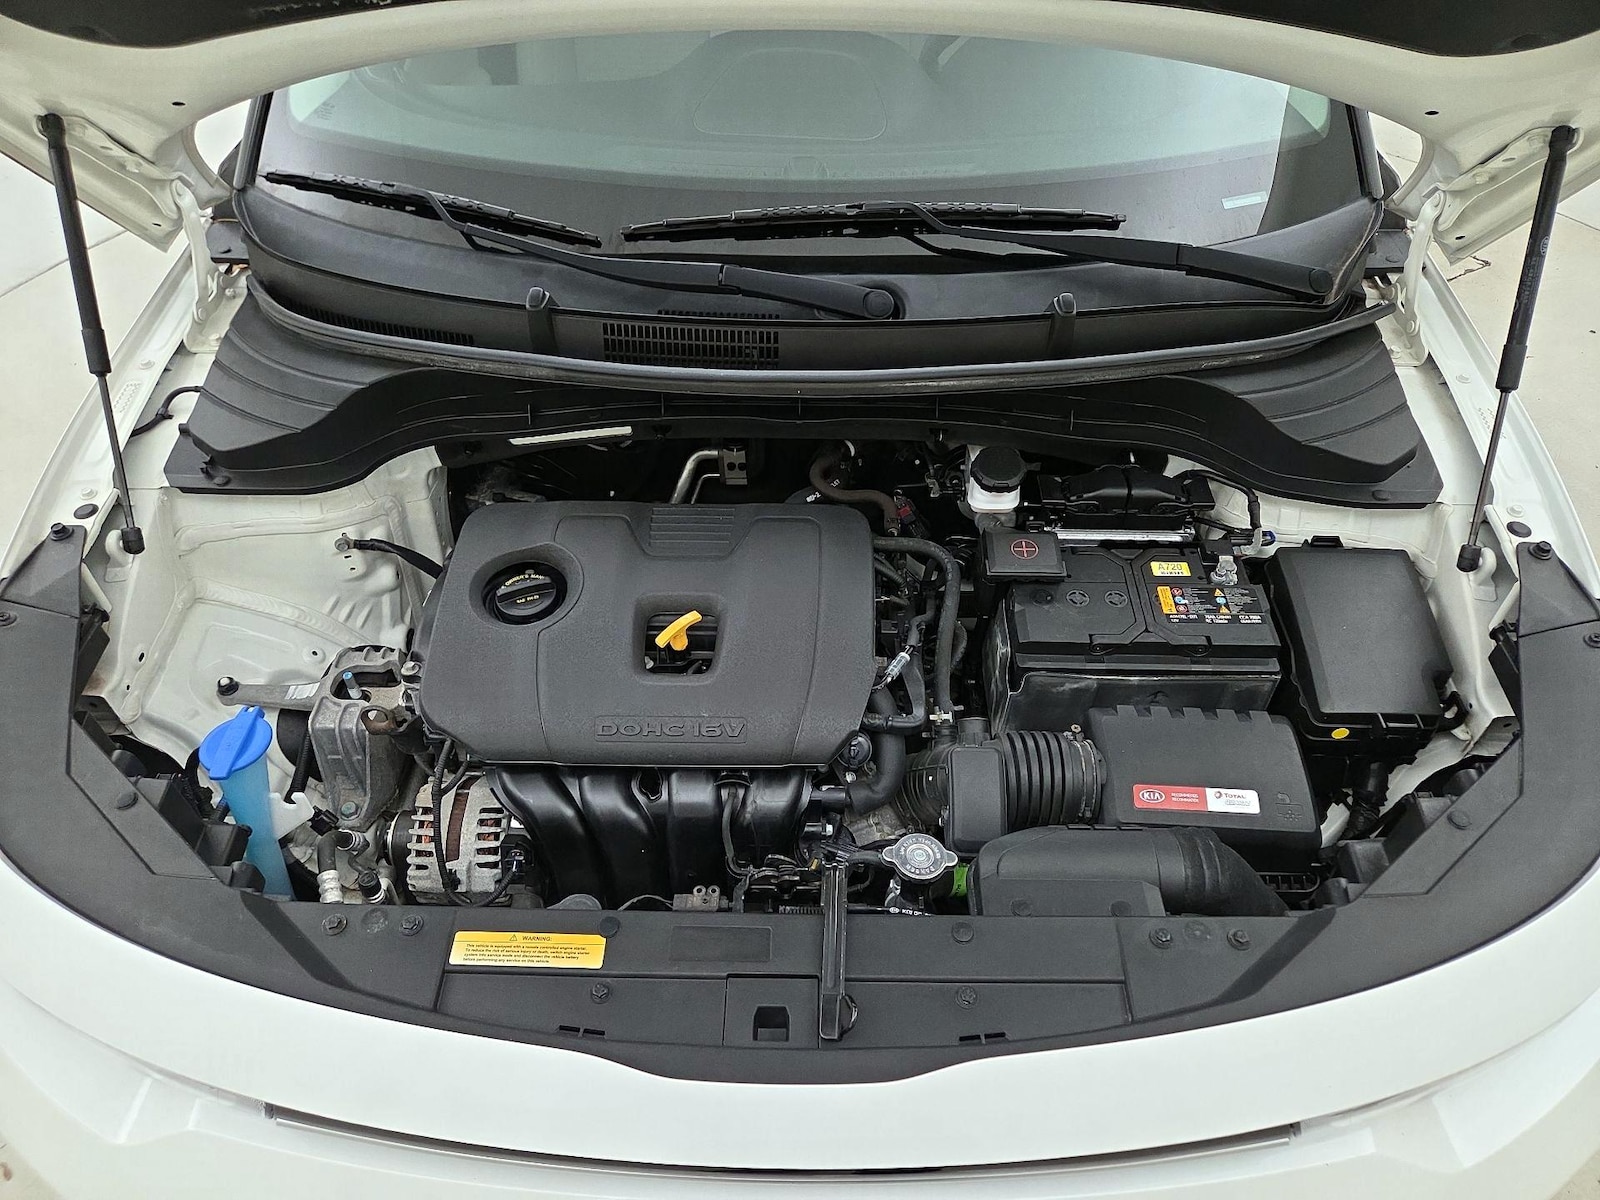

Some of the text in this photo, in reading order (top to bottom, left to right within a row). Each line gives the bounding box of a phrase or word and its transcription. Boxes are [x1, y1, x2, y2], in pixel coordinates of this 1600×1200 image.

[1159, 563, 1183, 571] A720
[596, 722, 746, 738] DOHC 16V
[1143, 791, 1161, 800] KIA
[1224, 792, 1246, 800] TOTAL
